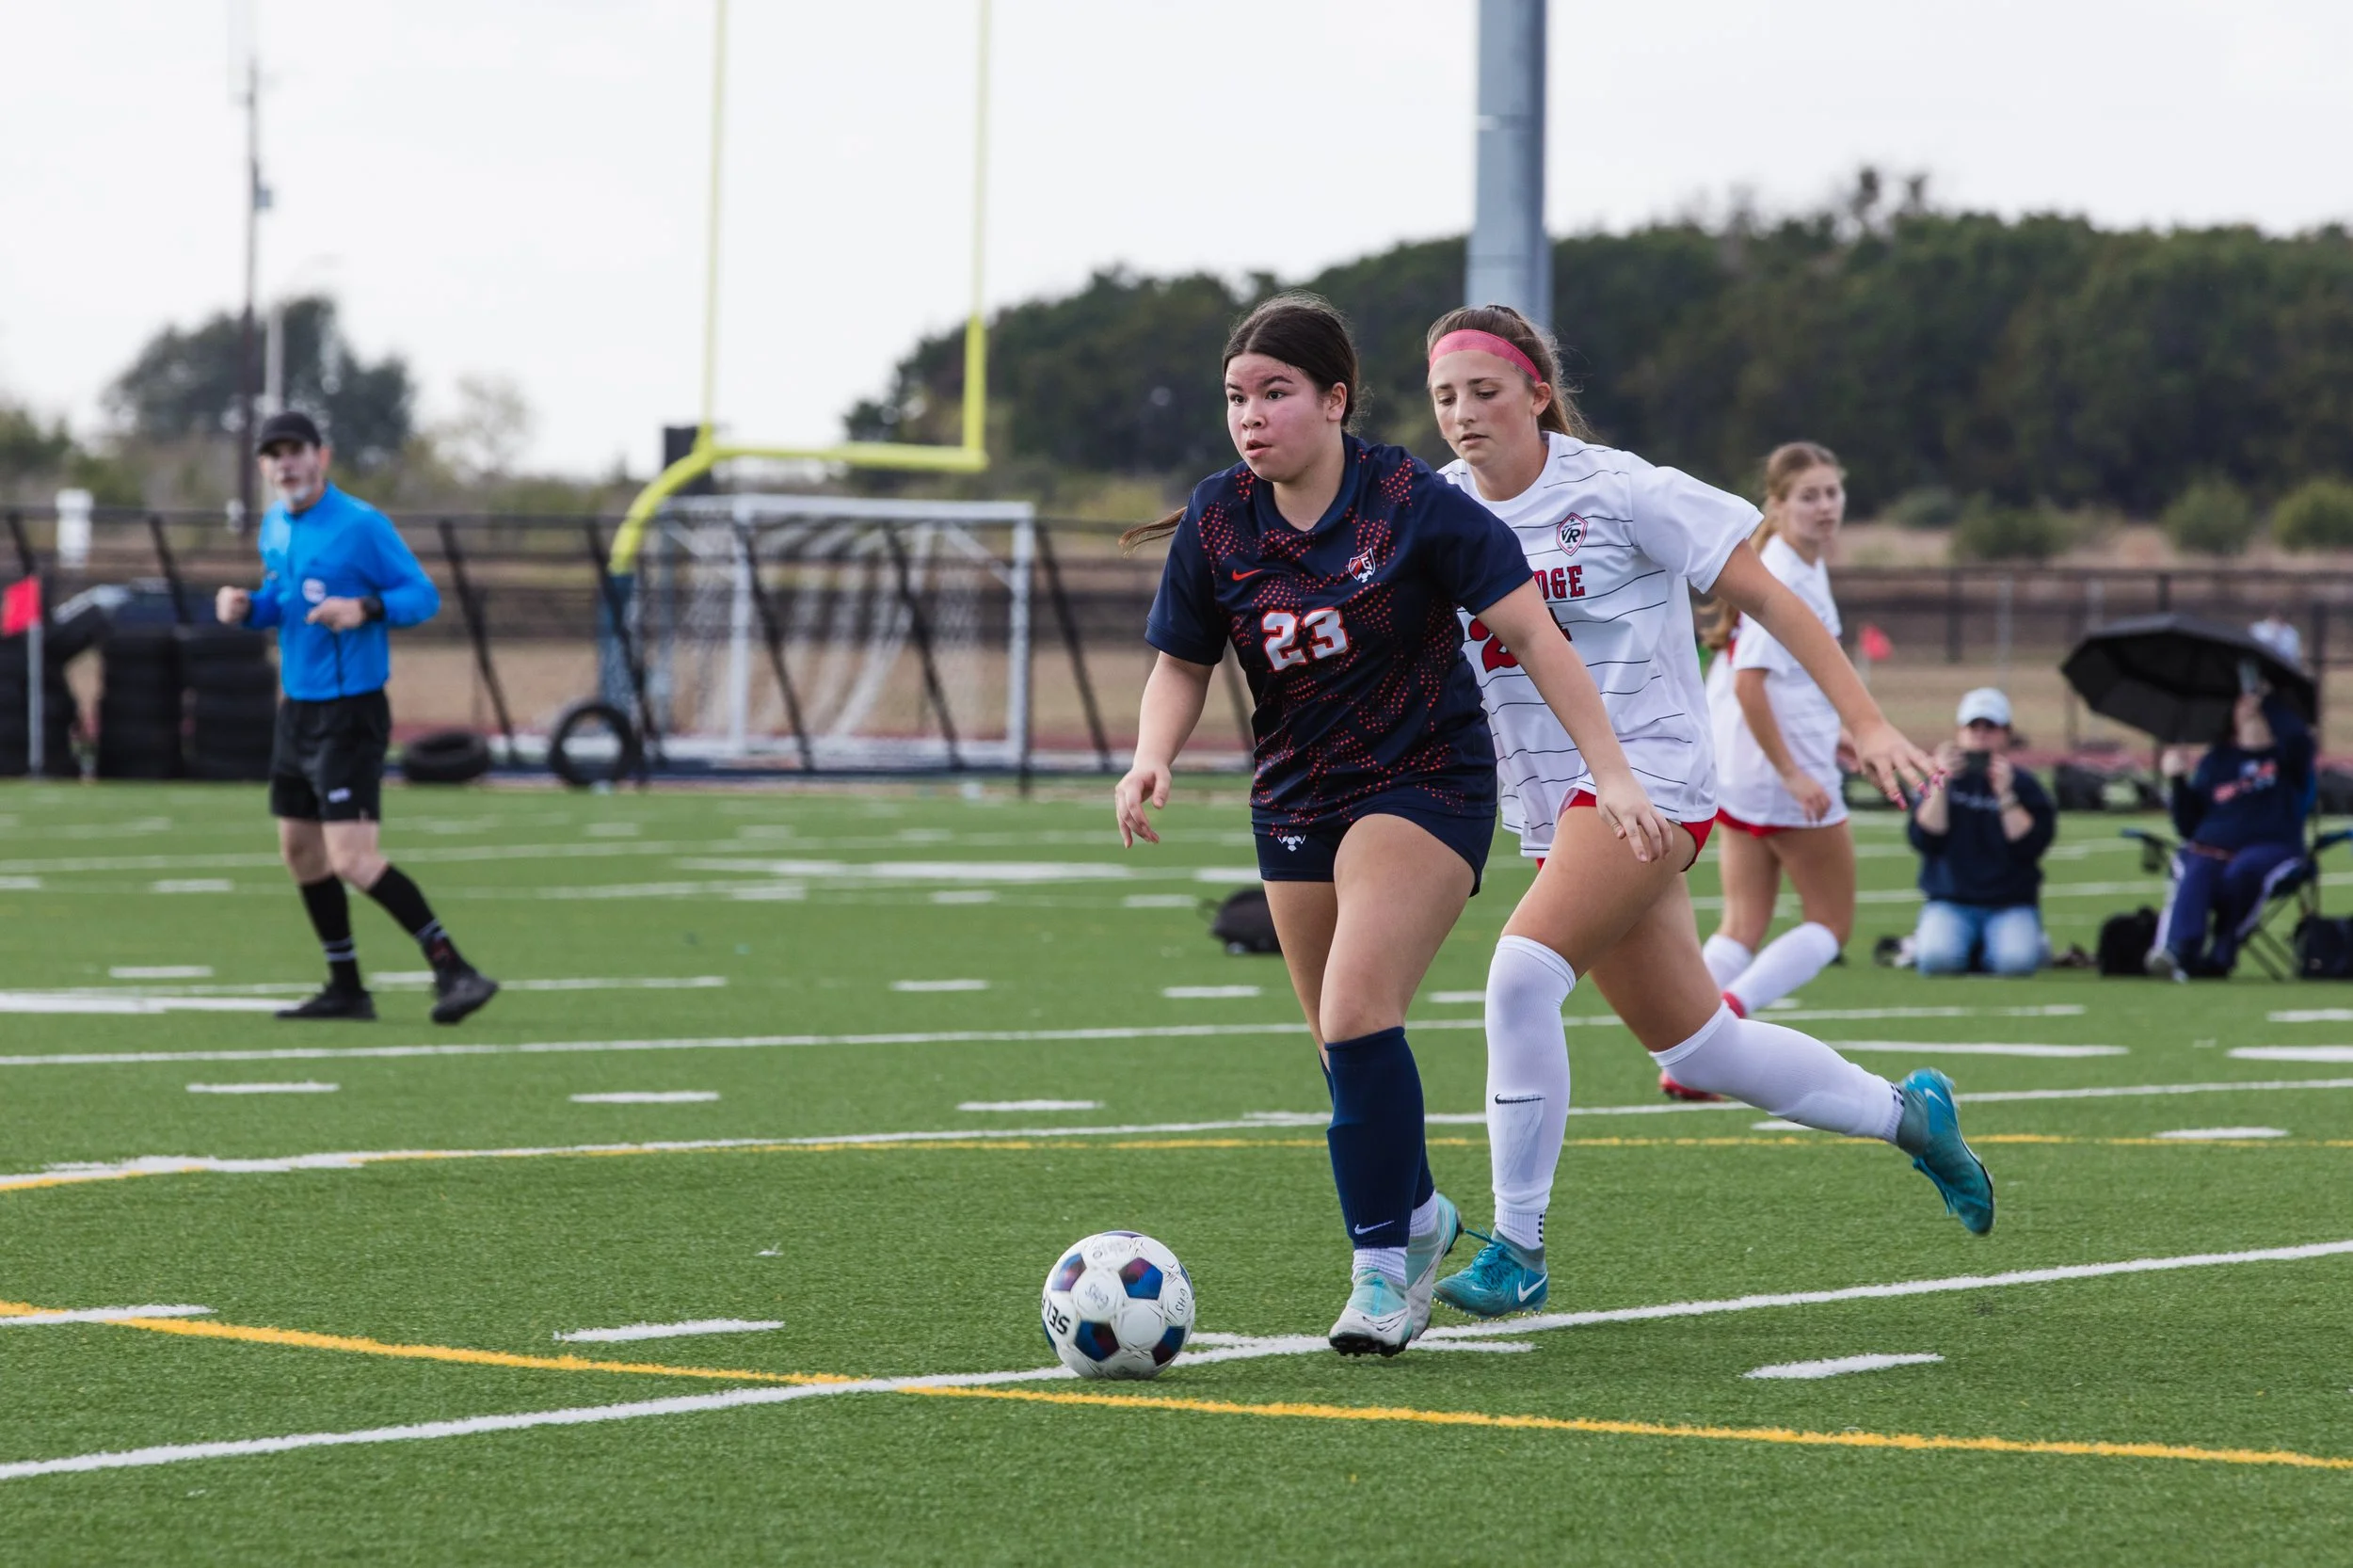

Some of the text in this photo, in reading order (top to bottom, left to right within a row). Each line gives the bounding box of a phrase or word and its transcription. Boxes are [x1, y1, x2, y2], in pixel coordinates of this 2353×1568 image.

[1561, 527, 1581, 543] VR
[1533, 565, 1586, 600] DGE
[1261, 607, 1352, 673] 23
